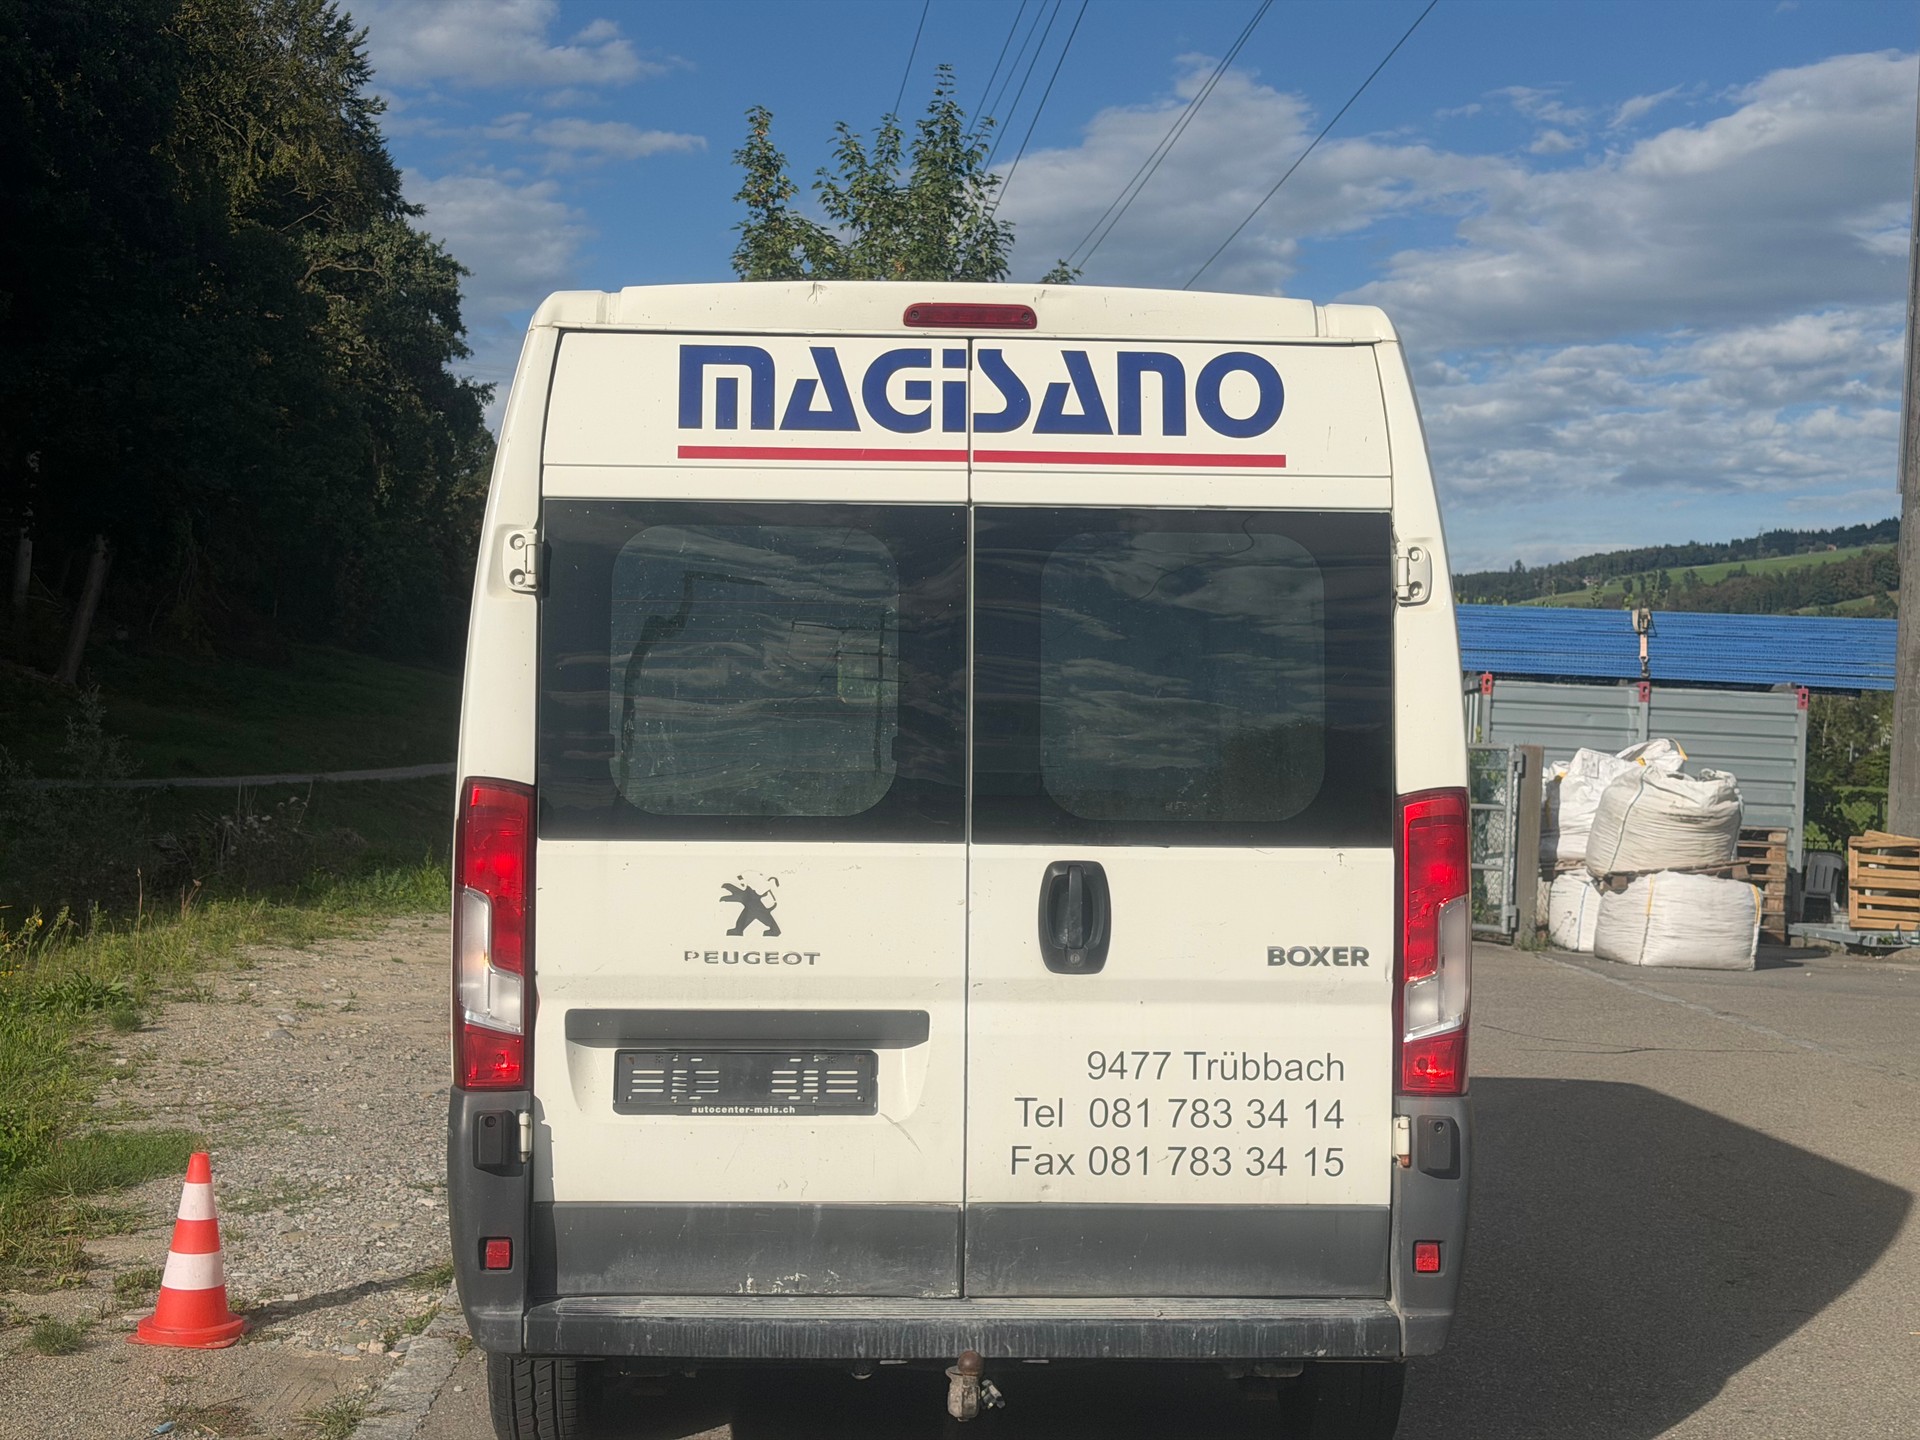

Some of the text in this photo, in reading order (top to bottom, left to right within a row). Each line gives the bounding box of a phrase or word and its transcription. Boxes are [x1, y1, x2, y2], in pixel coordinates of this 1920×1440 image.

[684, 950, 821, 966] PEUGEOT
[1267, 945, 1370, 967] BOXER
[1087, 1050, 1345, 1082] 9477 Trübbach
[691, 1105, 796, 1114] autocenter-mels.ch
[1014, 1097, 1345, 1130] Tel 081 783 34 14
[1010, 1145, 1345, 1177] Fax 081 783 34 15
